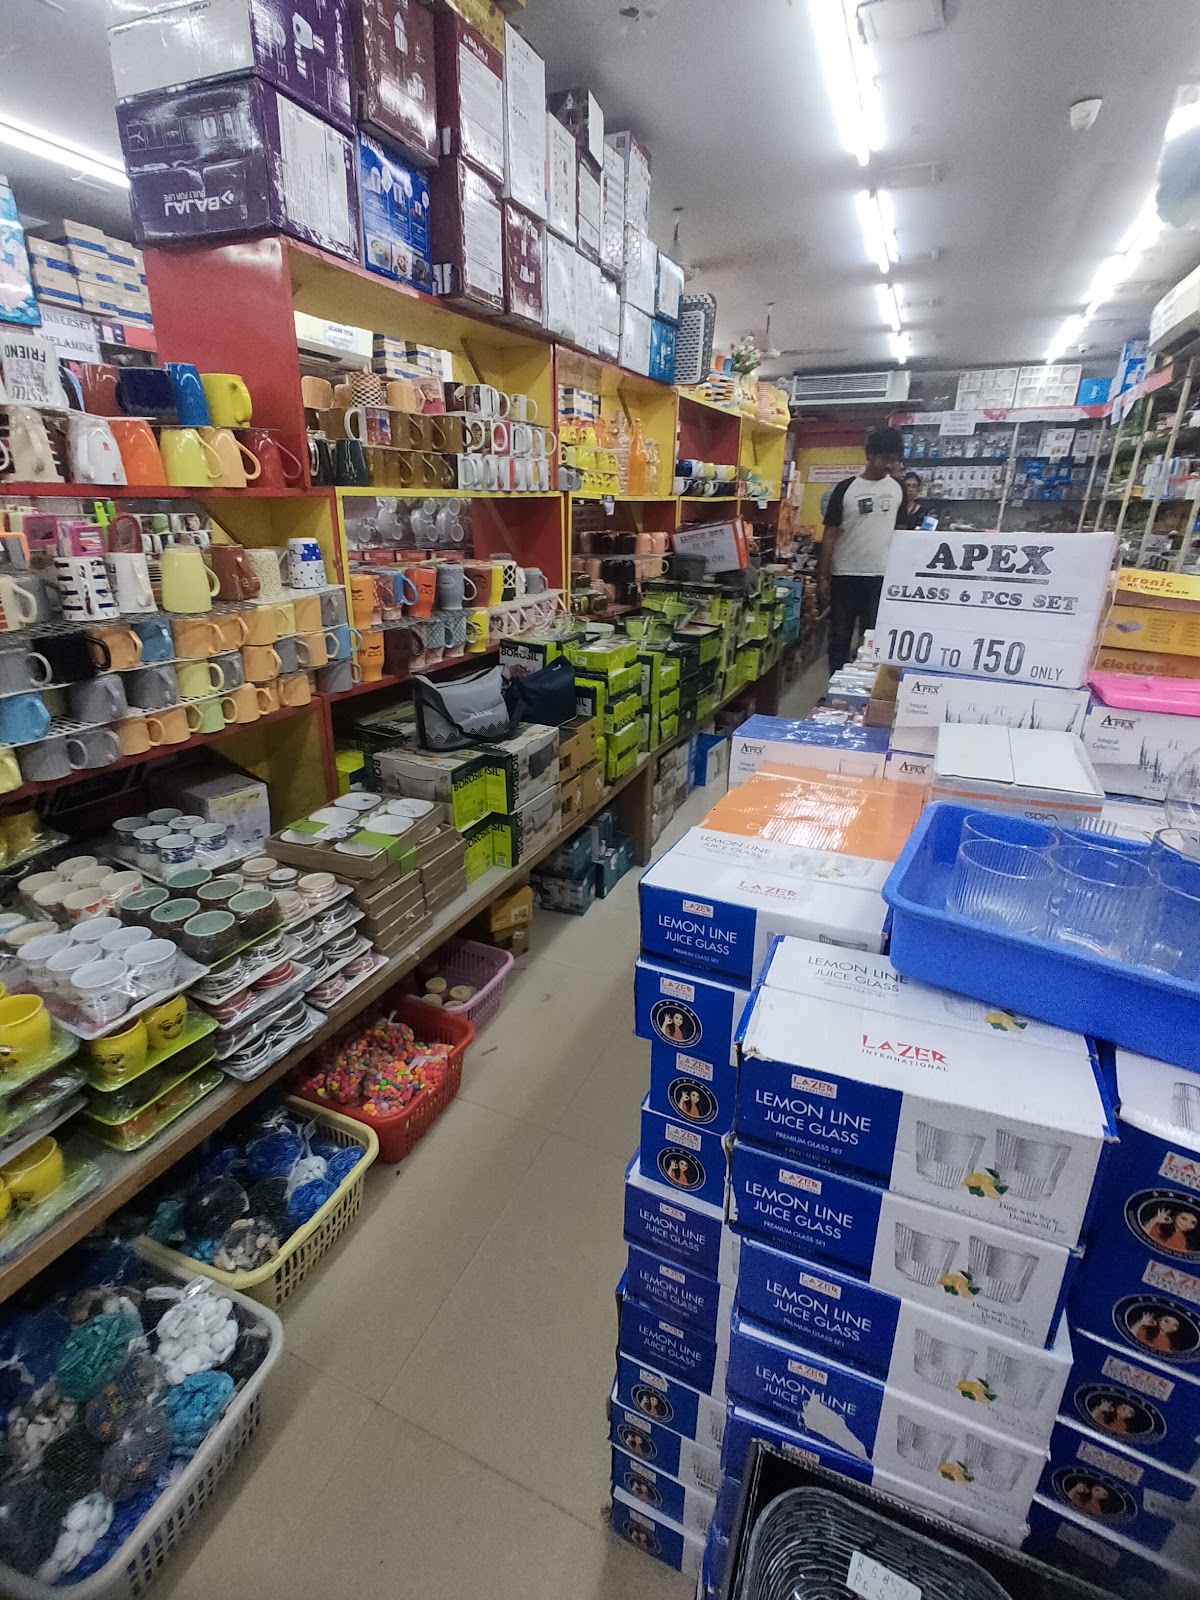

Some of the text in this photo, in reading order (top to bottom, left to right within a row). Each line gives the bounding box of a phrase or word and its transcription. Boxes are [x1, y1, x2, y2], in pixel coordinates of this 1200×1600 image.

[164, 196, 220, 216] BAJAJ
[4, 344, 46, 363] FRIEND
[926, 542, 1055, 576] APEX
[887, 584, 1078, 610] GLASS 6 PCS SET
[887, 629, 933, 664] 100
[941, 647, 961, 668] TO
[973, 637, 1026, 675] 150
[1030, 665, 1064, 682] ONLY
[453, 771, 484, 792] BOROSIL
[512, 754, 520, 802] BOROSIL
[700, 835, 744, 848] LEMON
[745, 844, 772, 855] LINE
[703, 842, 726, 850] JUICE
[730, 847, 762, 859] GLASS
[738, 879, 800, 899] LAZER
[684, 901, 713, 914] LAZER
[658, 914, 738, 944] LEMON LINE
[664, 931, 730, 956] JUICE GLASS
[694, 951, 709, 961] GLASS
[710, 956, 720, 964] SET
[808, 955, 909, 985] LEMON LINE
[661, 978, 693, 993] LAZER
[814, 968, 900, 993] JUICE GLASS
[861, 1034, 949, 1066] LAZER
[861, 1049, 949, 1072] INTERNATIONAL
[677, 1054, 712, 1072] LAZER
[793, 1075, 835, 1094] LAZER
[755, 1089, 872, 1133] LEMON LINE
[667, 1124, 700, 1142] LAZER
[763, 1110, 859, 1145] JUICE GLASS
[775, 1131, 806, 1145] PREMIUM
[807, 1139, 830, 1152] GLASS
[831, 1145, 843, 1155] SET
[780, 1170, 819, 1190] LAZER
[745, 1181, 854, 1229] LEMON LINE
[639, 1208, 706, 1245] LEMON LINE
[753, 1201, 842, 1239] JUICE GLASS
[644, 1222, 700, 1252] JUICE GLASS
[763, 1220, 826, 1248] PREMIUM GLASS SET
[639, 1270, 679, 1295] LEMON
[681, 1290, 705, 1307] LINE
[801, 1274, 839, 1295] LAZER
[644, 1284, 668, 1301] JUICE
[669, 1295, 699, 1314] GLASS
[766, 1280, 828, 1315] LEMON
[834, 1307, 872, 1332] LINE
[773, 1299, 861, 1342] JUICE GLASS
[783, 1318, 812, 1334] PREMIUM
[812, 1329, 833, 1343] GLASS
[638, 1324, 677, 1349] LEMON
[680, 1344, 702, 1362] LINE
[643, 1338, 667, 1355] JUICE
[668, 1348, 696, 1368] GLASS
[789, 1361, 825, 1381] LAZER
[755, 1365, 857, 1417] LEMON LINE
[762, 1383, 799, 1406] JUICE
